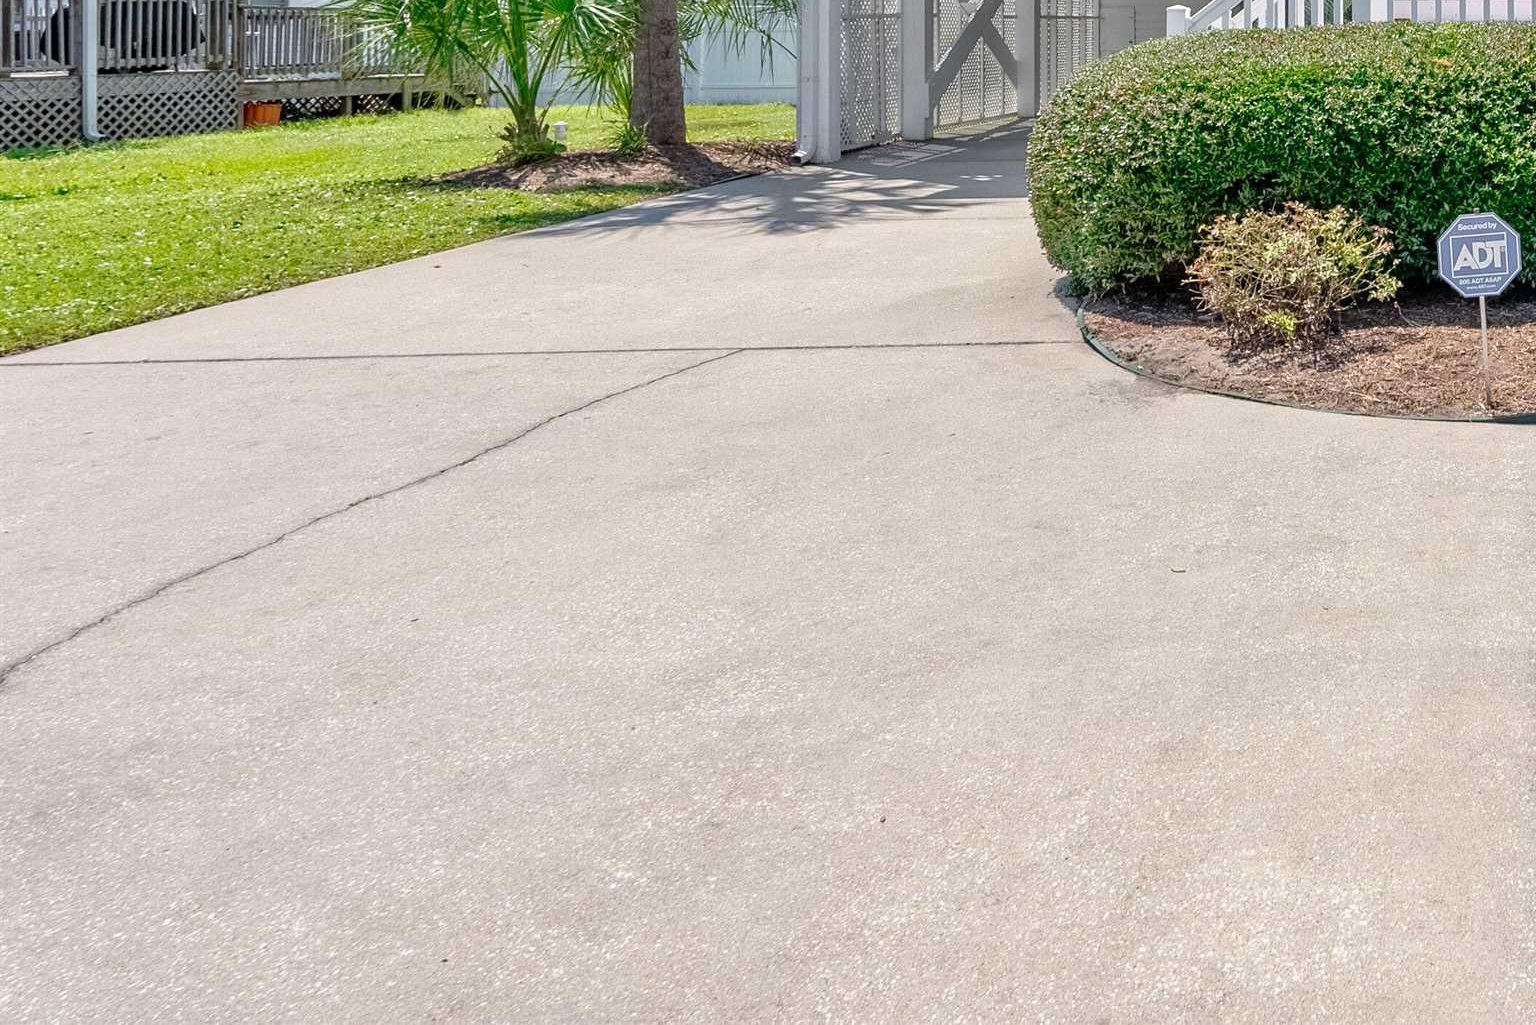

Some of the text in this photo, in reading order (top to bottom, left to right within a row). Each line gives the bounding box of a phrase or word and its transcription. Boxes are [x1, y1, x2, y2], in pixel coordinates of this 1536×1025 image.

[1458, 222, 1497, 231] Secured by
[1453, 241, 1506, 271] ADT
